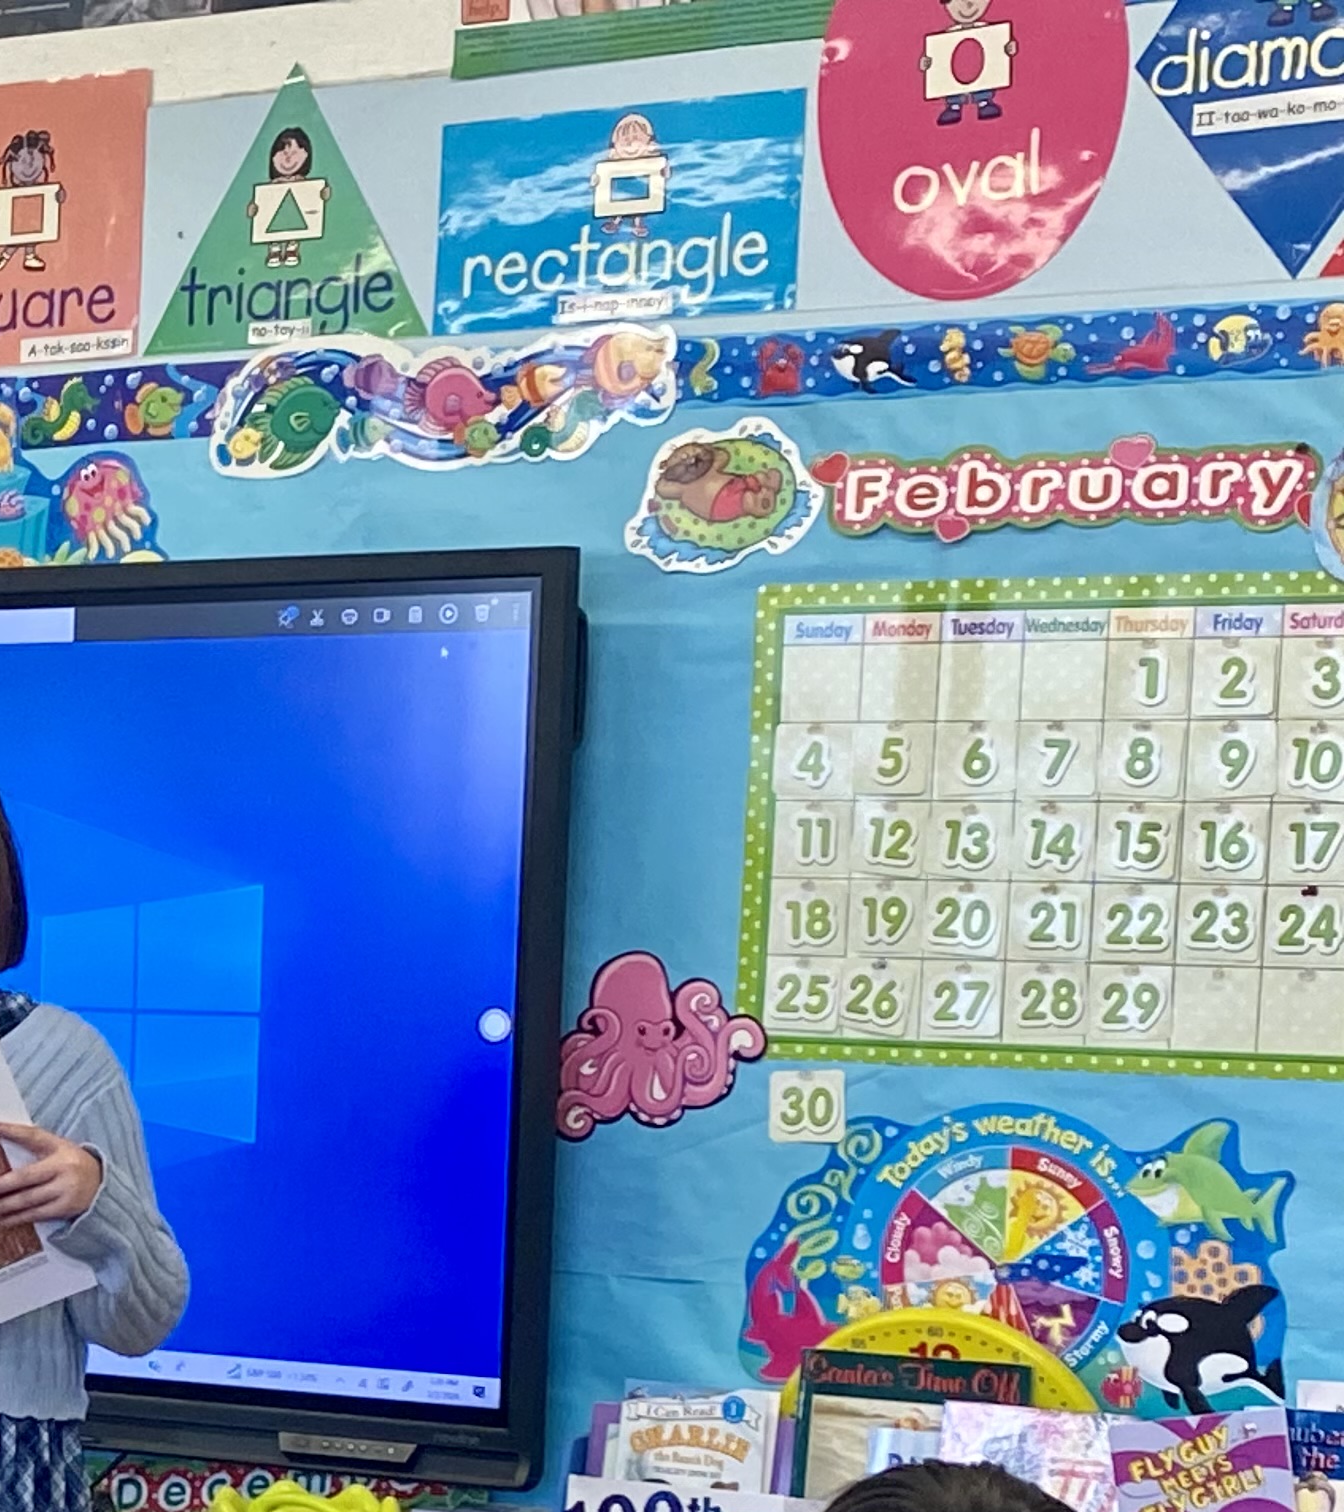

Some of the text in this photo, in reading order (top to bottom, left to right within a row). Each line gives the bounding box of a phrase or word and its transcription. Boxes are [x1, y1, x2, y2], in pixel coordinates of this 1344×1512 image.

[892, 127, 1043, 214] oval
[463, 212, 769, 303] rectangle
[180, 253, 395, 335] triangle
[845, 458, 1305, 521] February
[793, 613, 1264, 642] Sunday Monday Tuesday Wednesday Thursday Friday
[1138, 656, 1341, 700] 1 2 3
[796, 737, 1342, 783] 4 5 6 7 8 9 10
[797, 818, 1340, 865] 11 12 13 14 15 16 17
[785, 896, 1339, 948] 18 19 20 21 22 23 24
[776, 974, 1161, 1024] 25 26 27 28 29
[779, 1086, 833, 1126] 30
[878, 1109, 1092, 1189] Today's weather
[937, 1155, 983, 1179] Windy
[1037, 1158, 1083, 1189] Sunny
[885, 1212, 911, 1263] Cloudy
[1102, 1226, 1125, 1279] Snowy
[1064, 1319, 1111, 1370] Stormy
[971, 1367, 1021, 1405] Off
[1128, 1425, 1229, 1483] FLY GUY
[1161, 1453, 1233, 1495] MEETS
[1190, 1464, 1265, 1508] GIRL!
